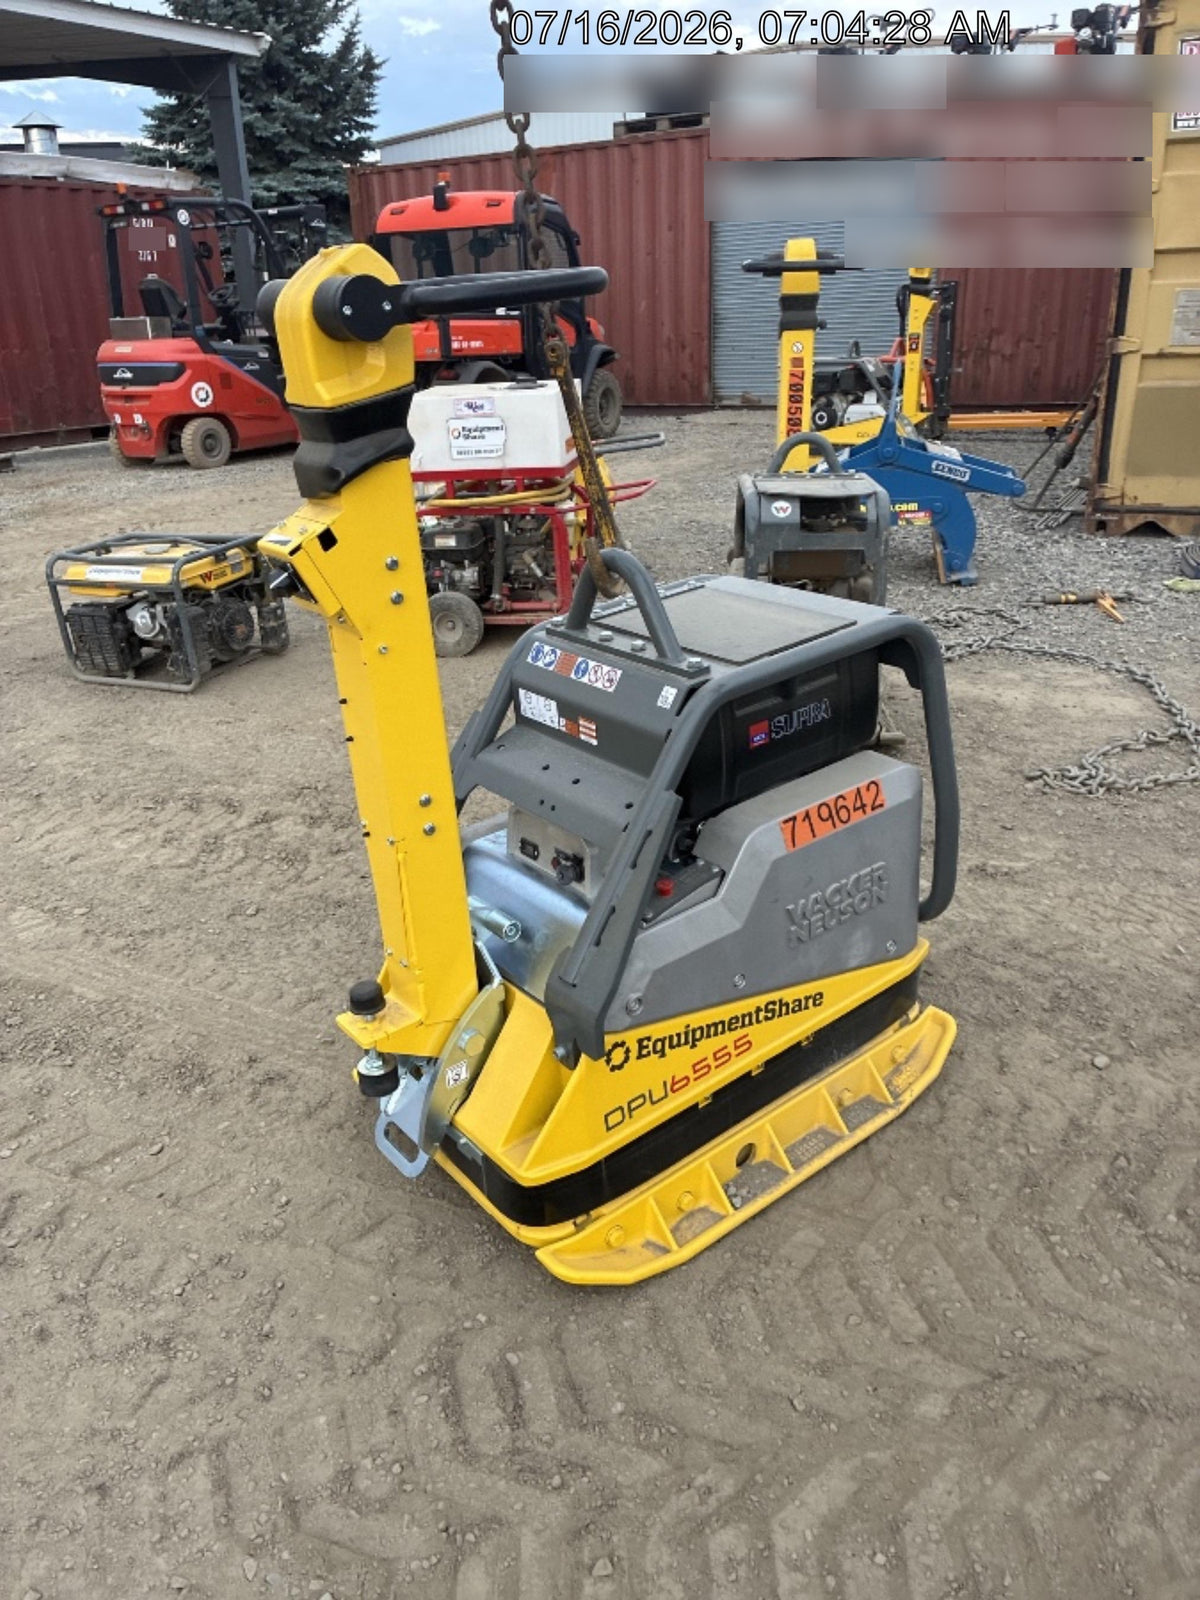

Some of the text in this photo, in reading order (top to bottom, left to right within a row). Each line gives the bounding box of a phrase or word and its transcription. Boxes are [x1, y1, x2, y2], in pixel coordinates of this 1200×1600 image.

[771, 698, 832, 739] SUPRA
[781, 780, 885, 849] 719642
[785, 861, 889, 926] WACKER
[787, 886, 887, 945] NEUSON
[635, 991, 825, 1060] EquipmentShare
[603, 1033, 753, 1133] DPU6555
